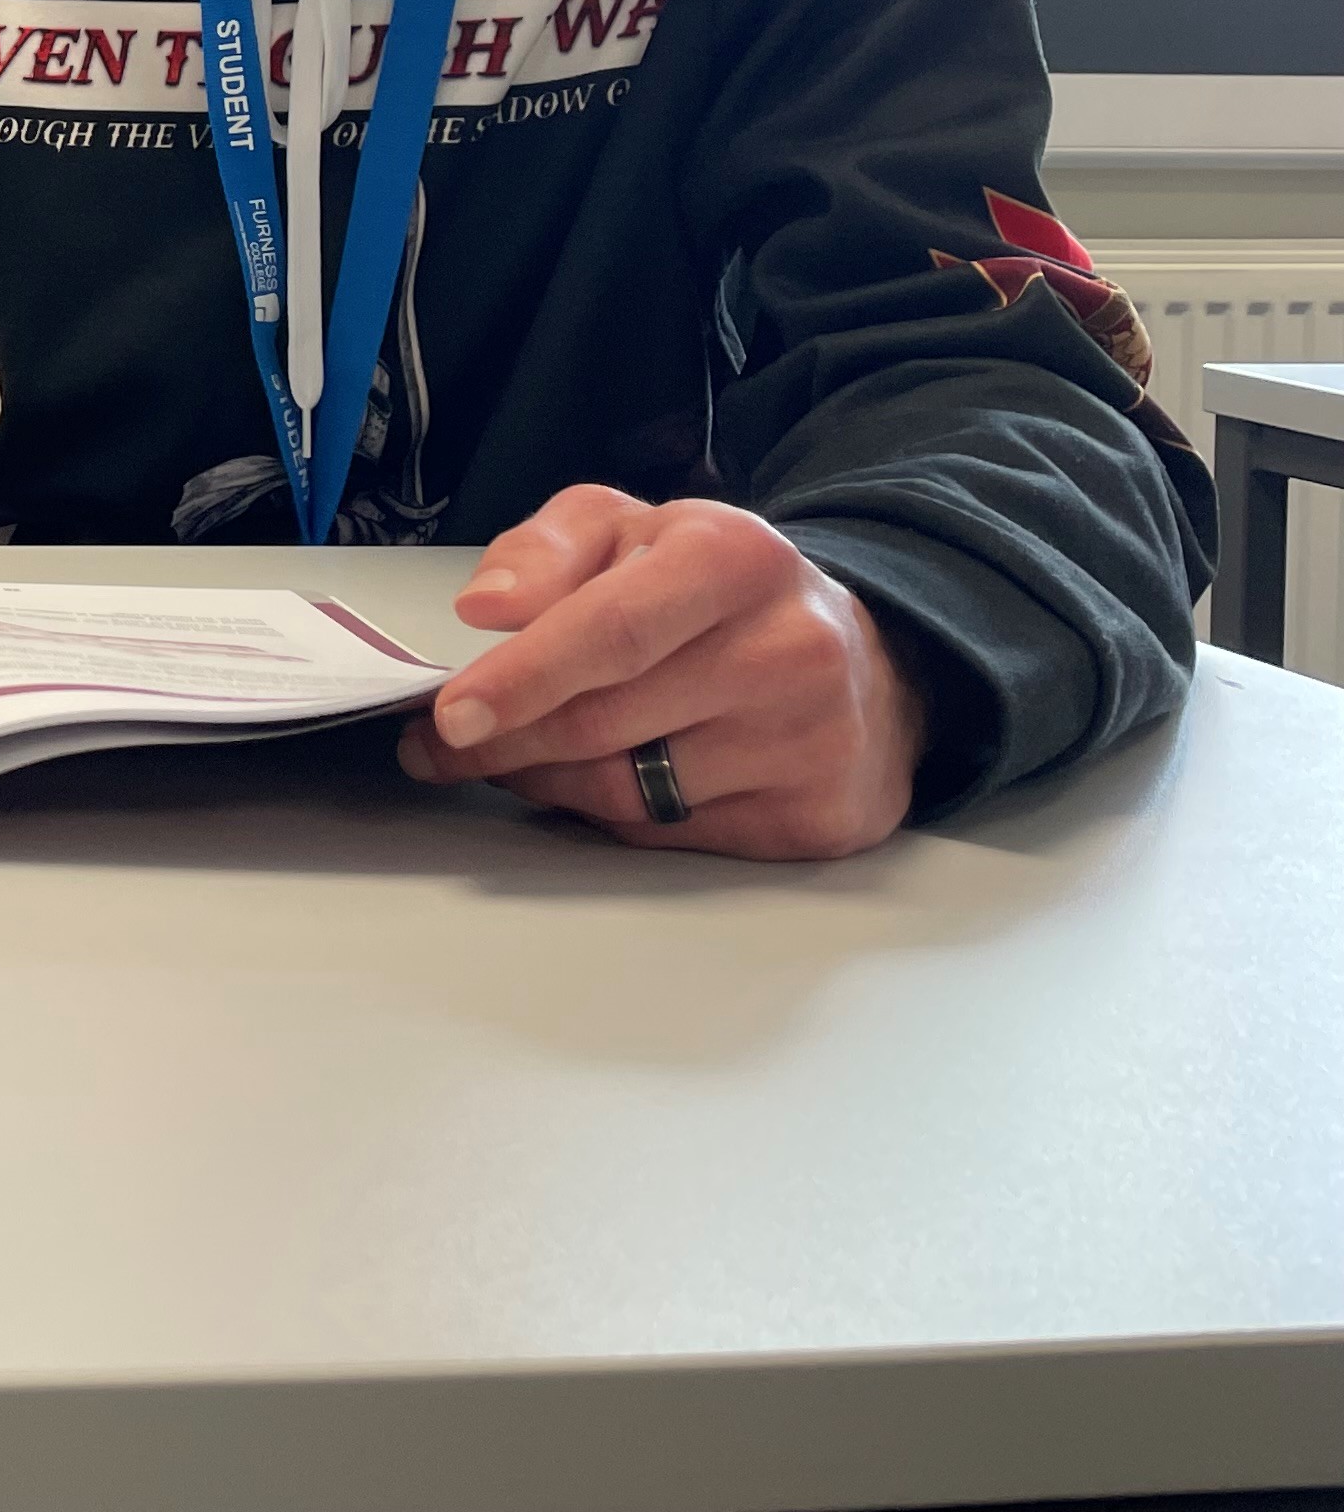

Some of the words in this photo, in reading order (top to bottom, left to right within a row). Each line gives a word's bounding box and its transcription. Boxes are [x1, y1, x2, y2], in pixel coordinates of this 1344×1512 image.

[217, 19, 254, 151] STUDENT
[108, 121, 177, 150] THE
[249, 198, 278, 290] FURNESS
